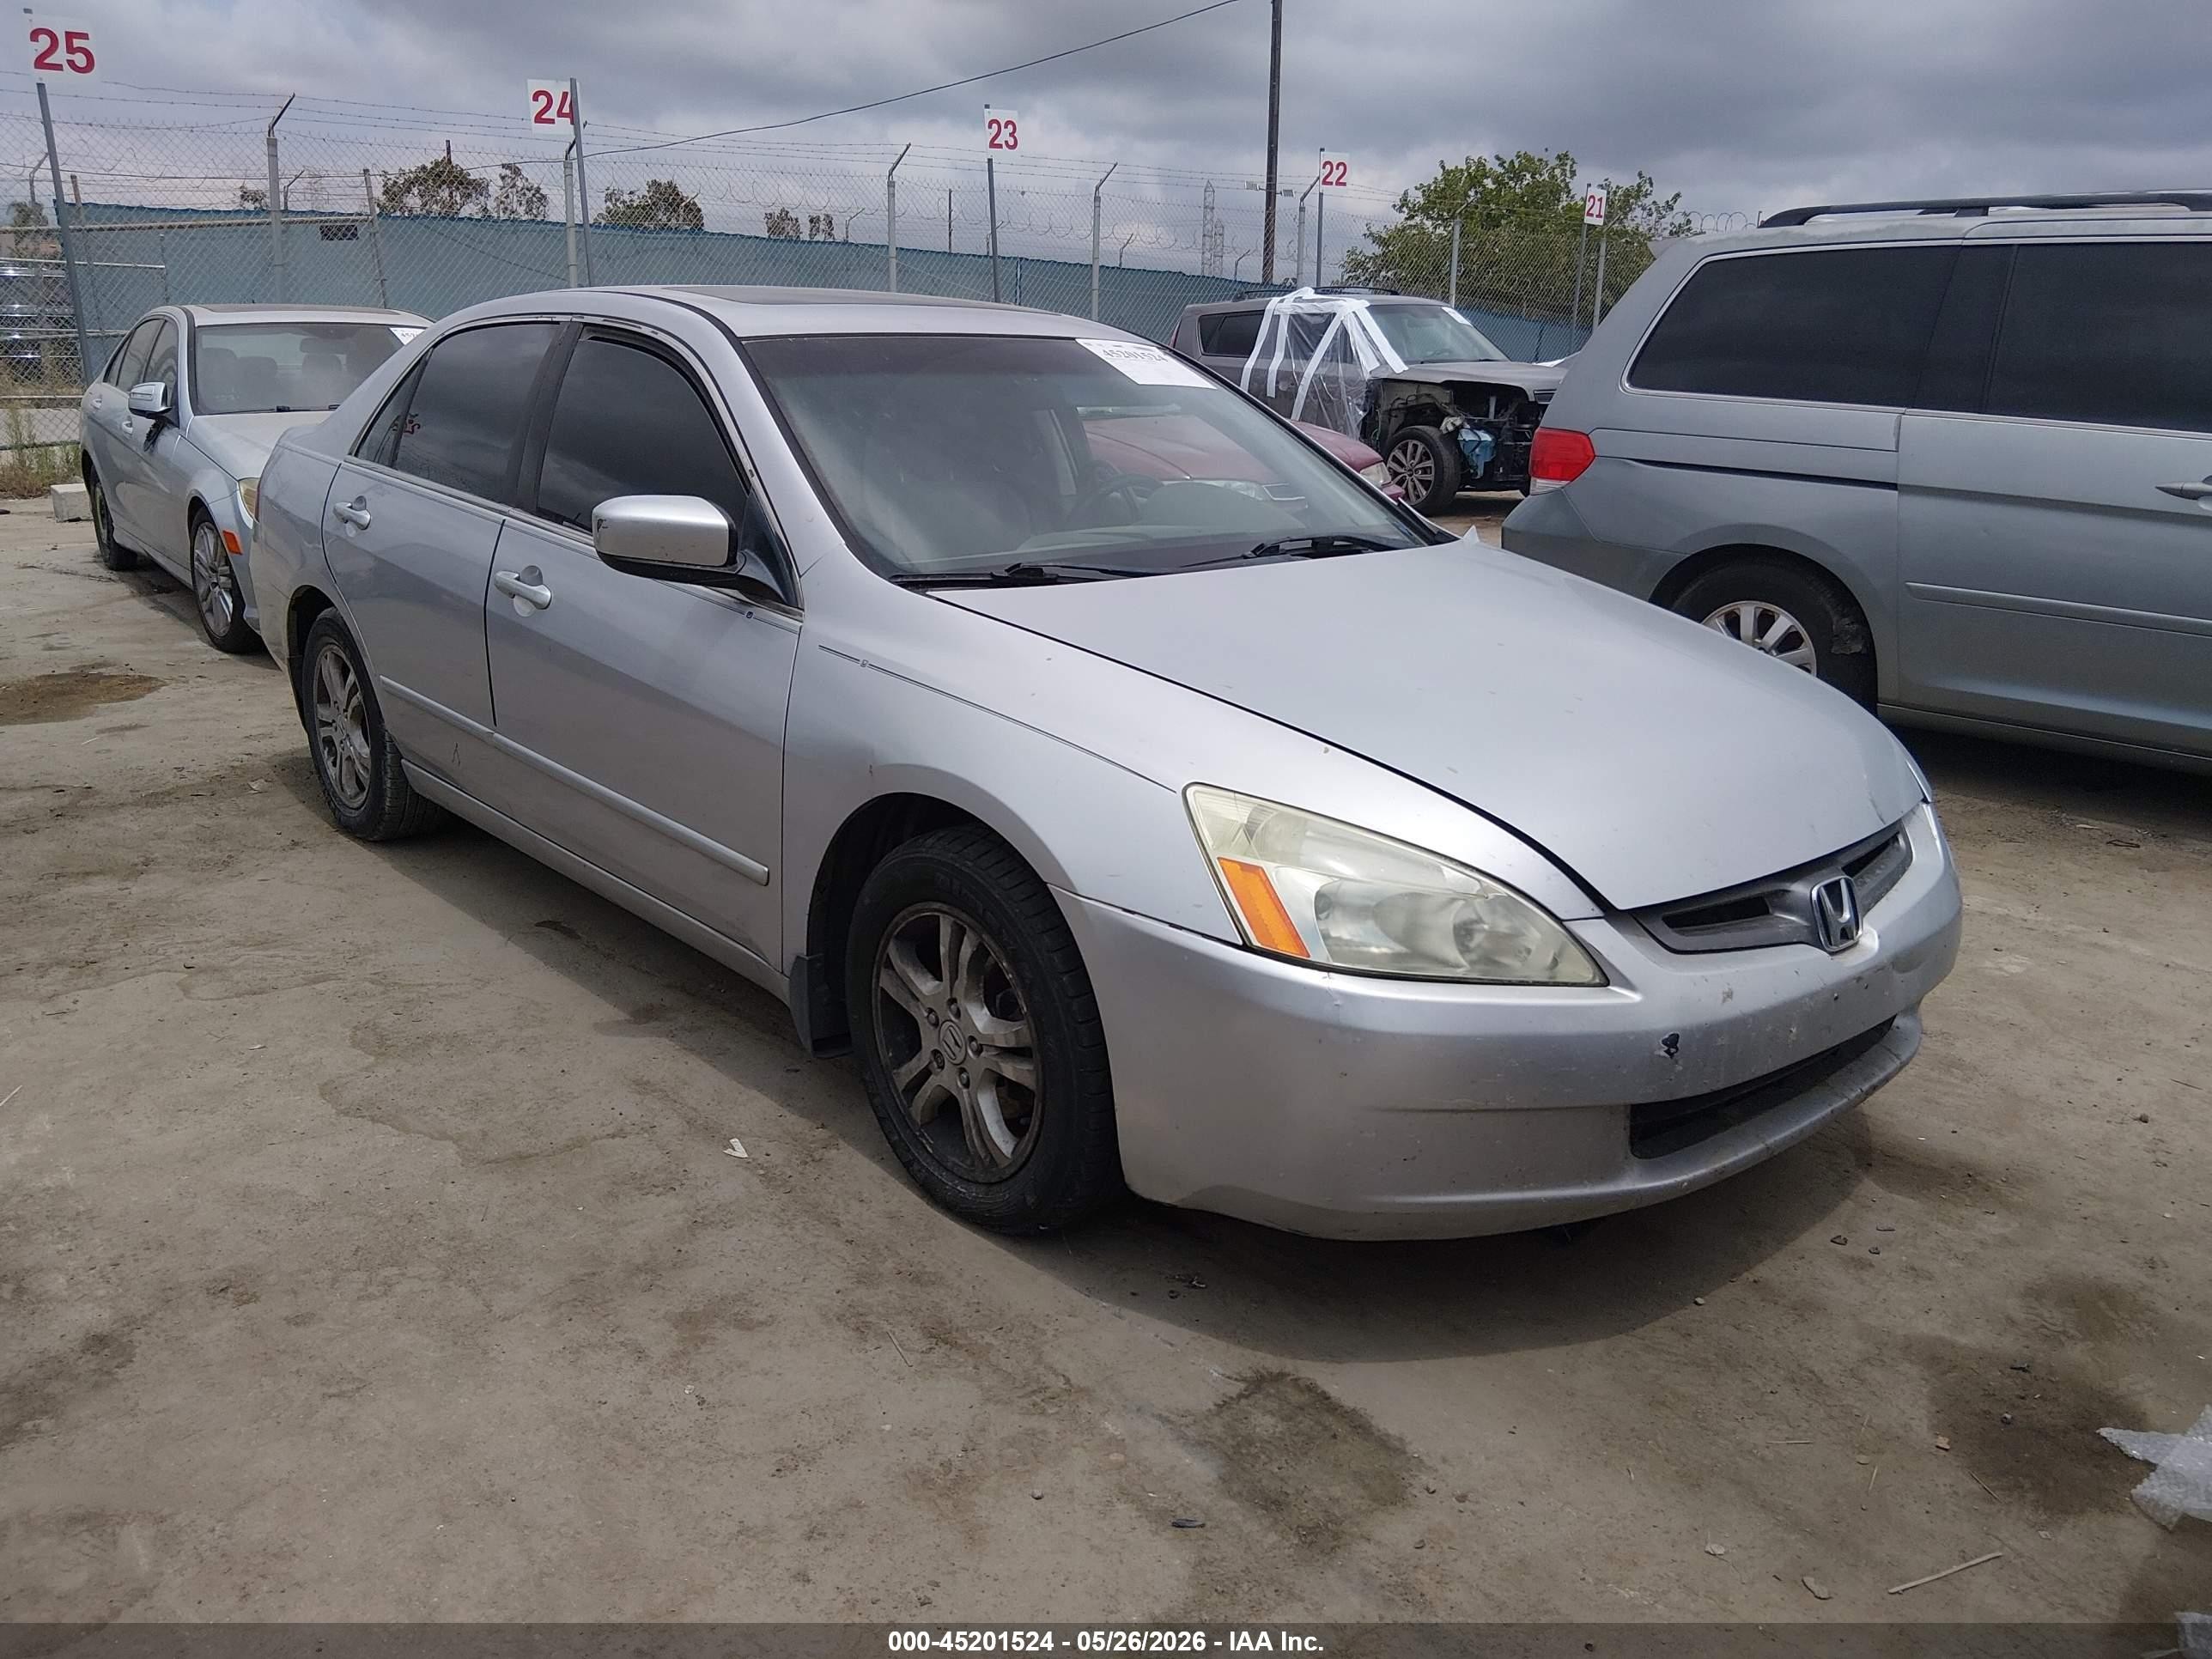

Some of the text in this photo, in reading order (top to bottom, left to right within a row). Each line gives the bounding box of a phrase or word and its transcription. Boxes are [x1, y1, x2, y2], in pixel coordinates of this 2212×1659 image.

[29, 27, 95, 74] 25
[532, 90, 574, 125] 24
[988, 118, 1018, 150] 23
[1321, 160, 1347, 187] 22
[1585, 194, 1603, 219] 21
